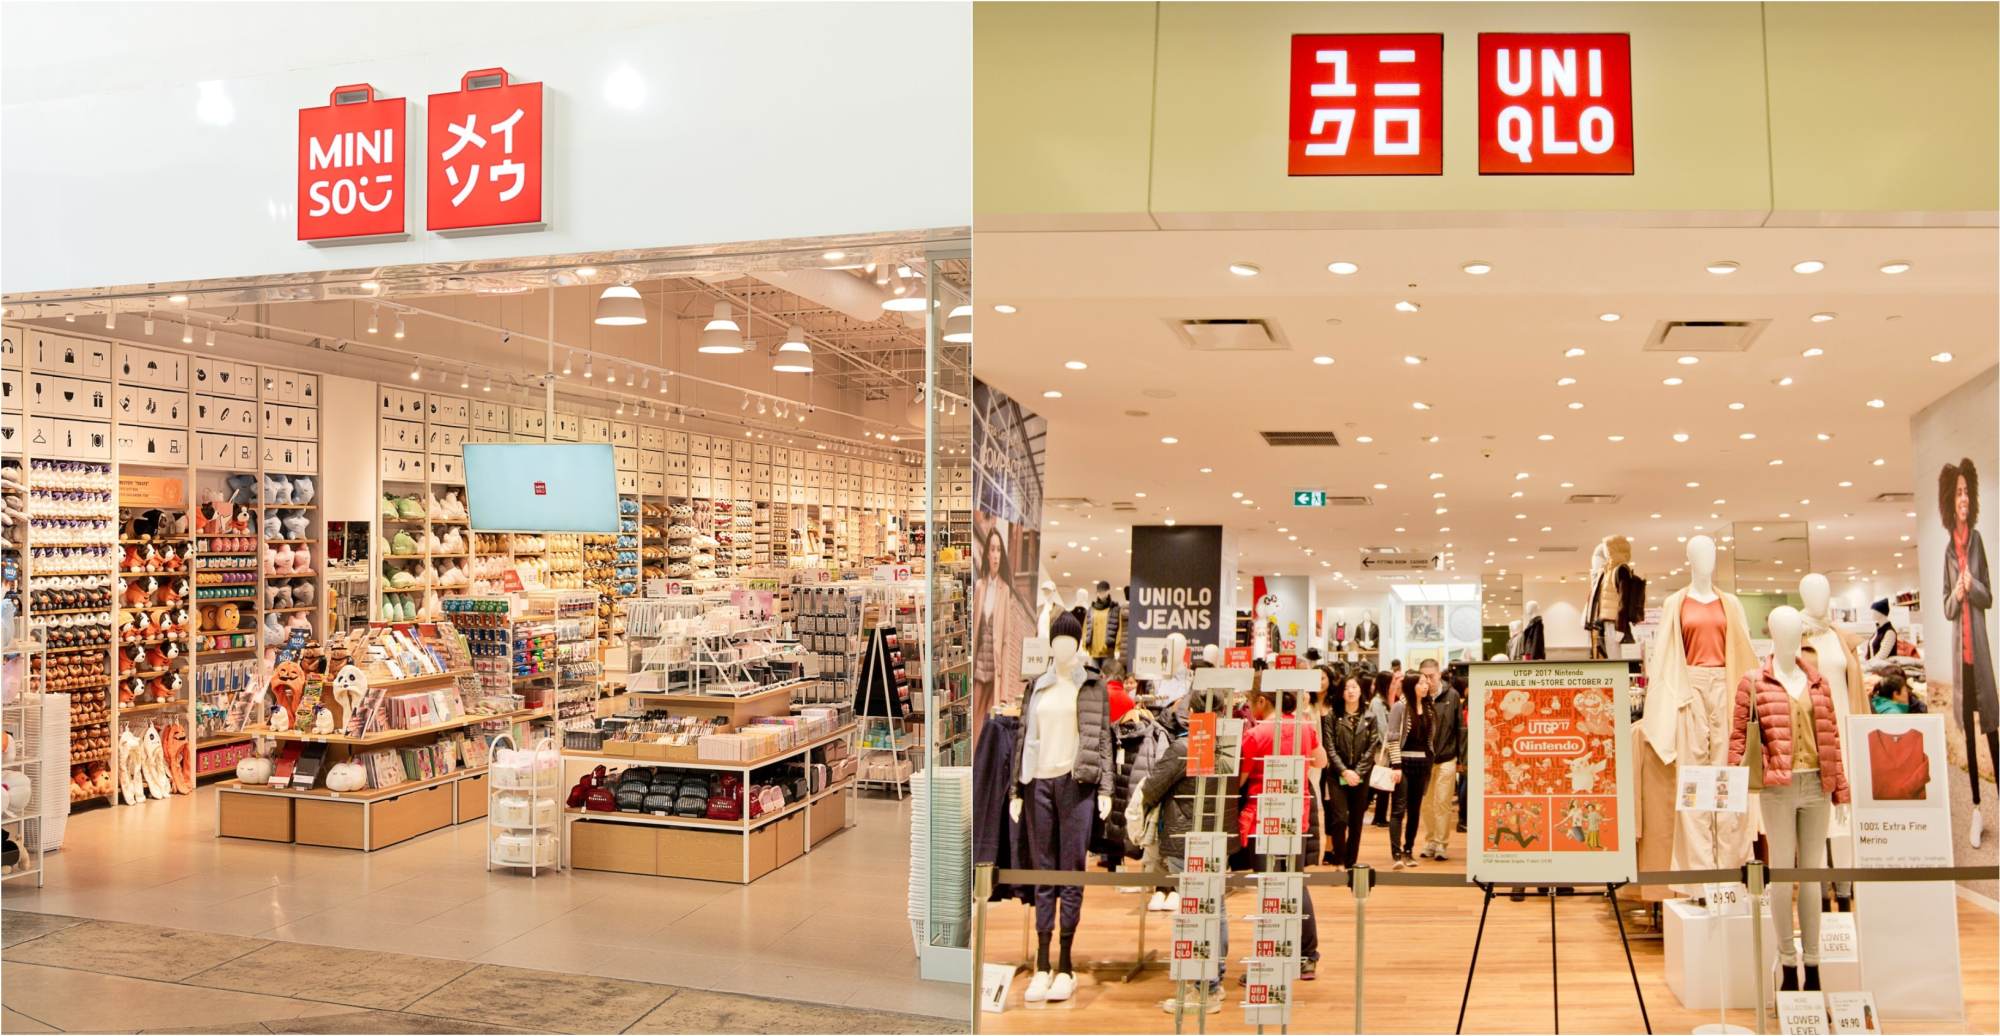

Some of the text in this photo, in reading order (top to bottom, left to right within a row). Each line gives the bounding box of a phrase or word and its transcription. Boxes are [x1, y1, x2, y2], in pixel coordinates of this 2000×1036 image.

[1310, 49, 1421, 97] ユニ
[1496, 48, 1602, 97] UNI
[441, 108, 525, 161] メイ
[1304, 108, 1420, 156] クロ
[1497, 105, 1615, 163] QLO
[309, 128, 393, 171] MINI
[445, 159, 525, 208] ソウ
[1138, 587, 1212, 609] UNIQLO
[1138, 609, 1211, 630] JEANS
[1535, 669, 1552, 677] 2017
[1554, 668, 1584, 676] Nintendo
[1484, 679, 1526, 687] AVAILABLE
[1528, 678, 1564, 686] IN-STORE
[1520, 741, 1580, 751] Nintendo
[1882, 822, 1906, 831] Extra
[1909, 822, 1927, 831] Fine
[1860, 836, 1888, 844] Merino
[1821, 932, 1850, 941] LOWER
[1824, 943, 1850, 952] LEVEL
[1786, 1016, 1820, 1024] LOWER
[1790, 1027, 1820, 1035] LEVEL
